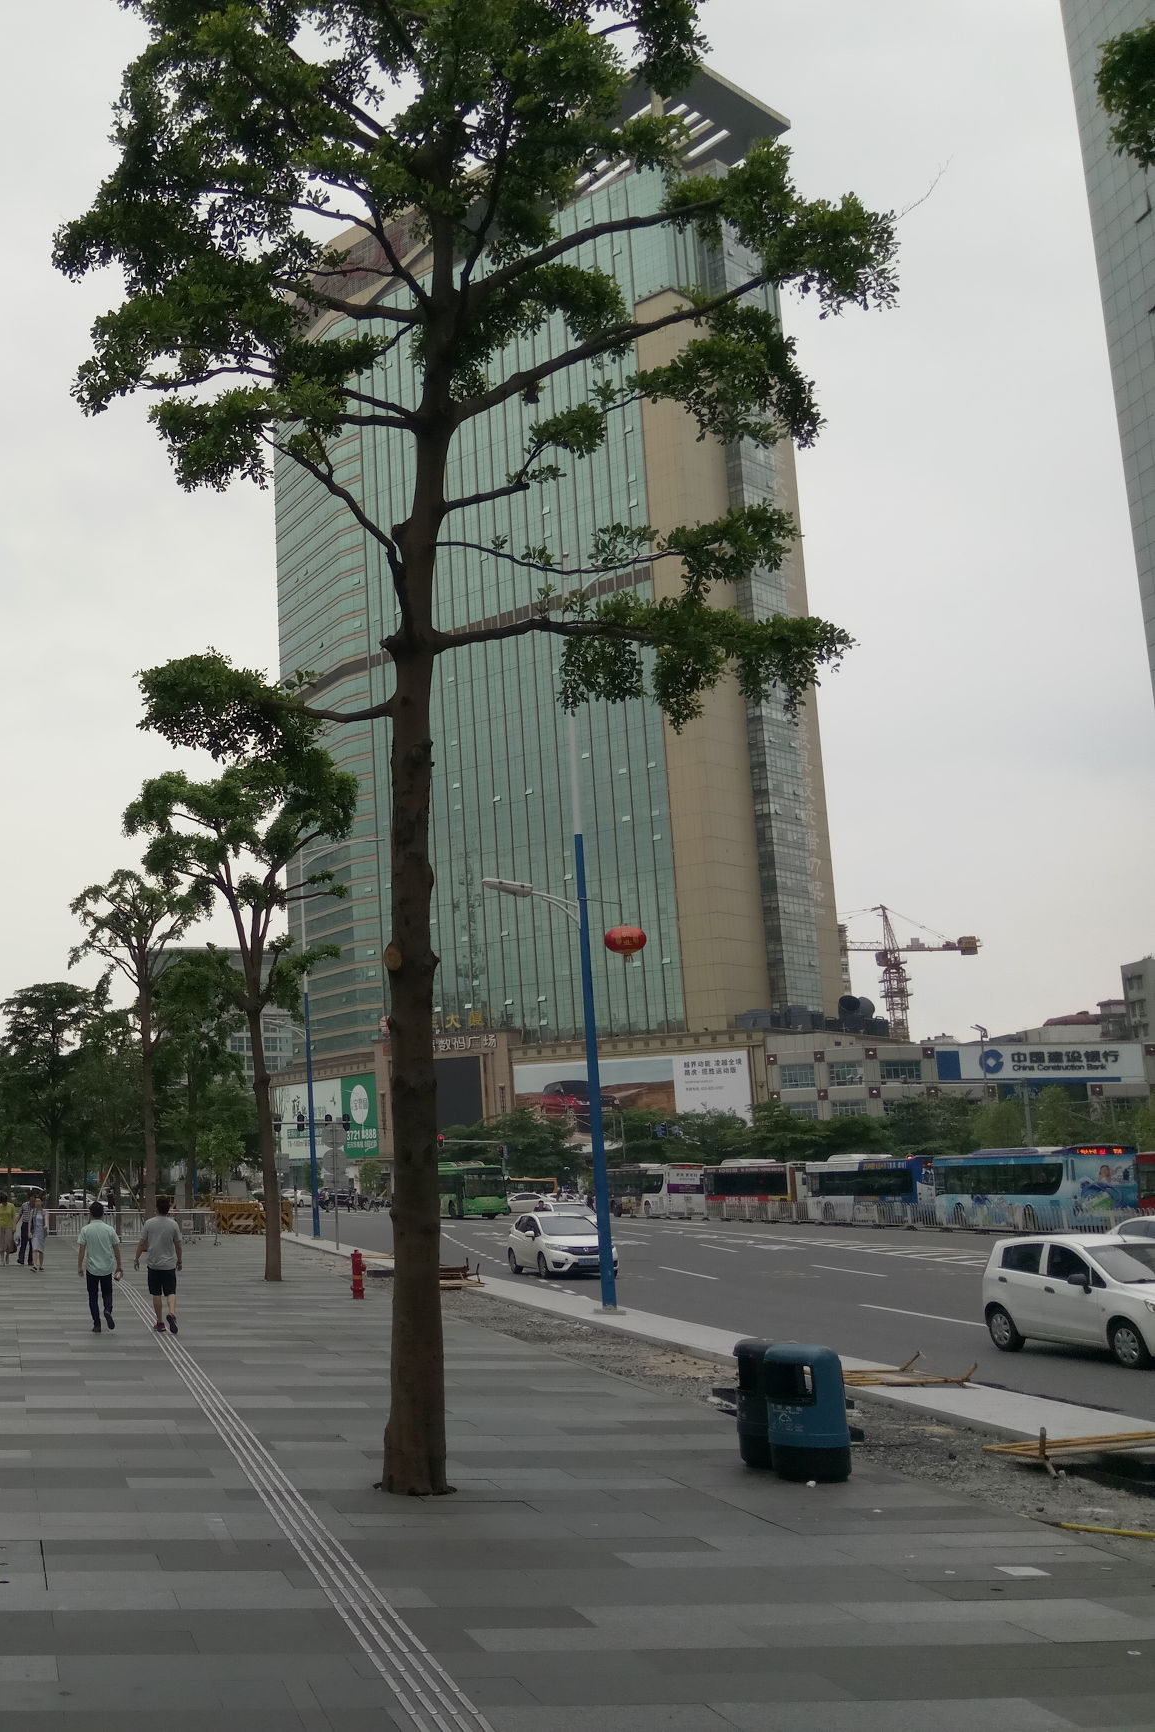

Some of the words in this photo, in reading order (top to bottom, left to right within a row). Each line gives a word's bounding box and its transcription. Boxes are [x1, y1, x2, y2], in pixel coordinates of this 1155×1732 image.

[1011, 1050, 1119, 1064] 中国建设银行
[1037, 1063, 1085, 1071] Construction
[1086, 1063, 1107, 1071] Bank
